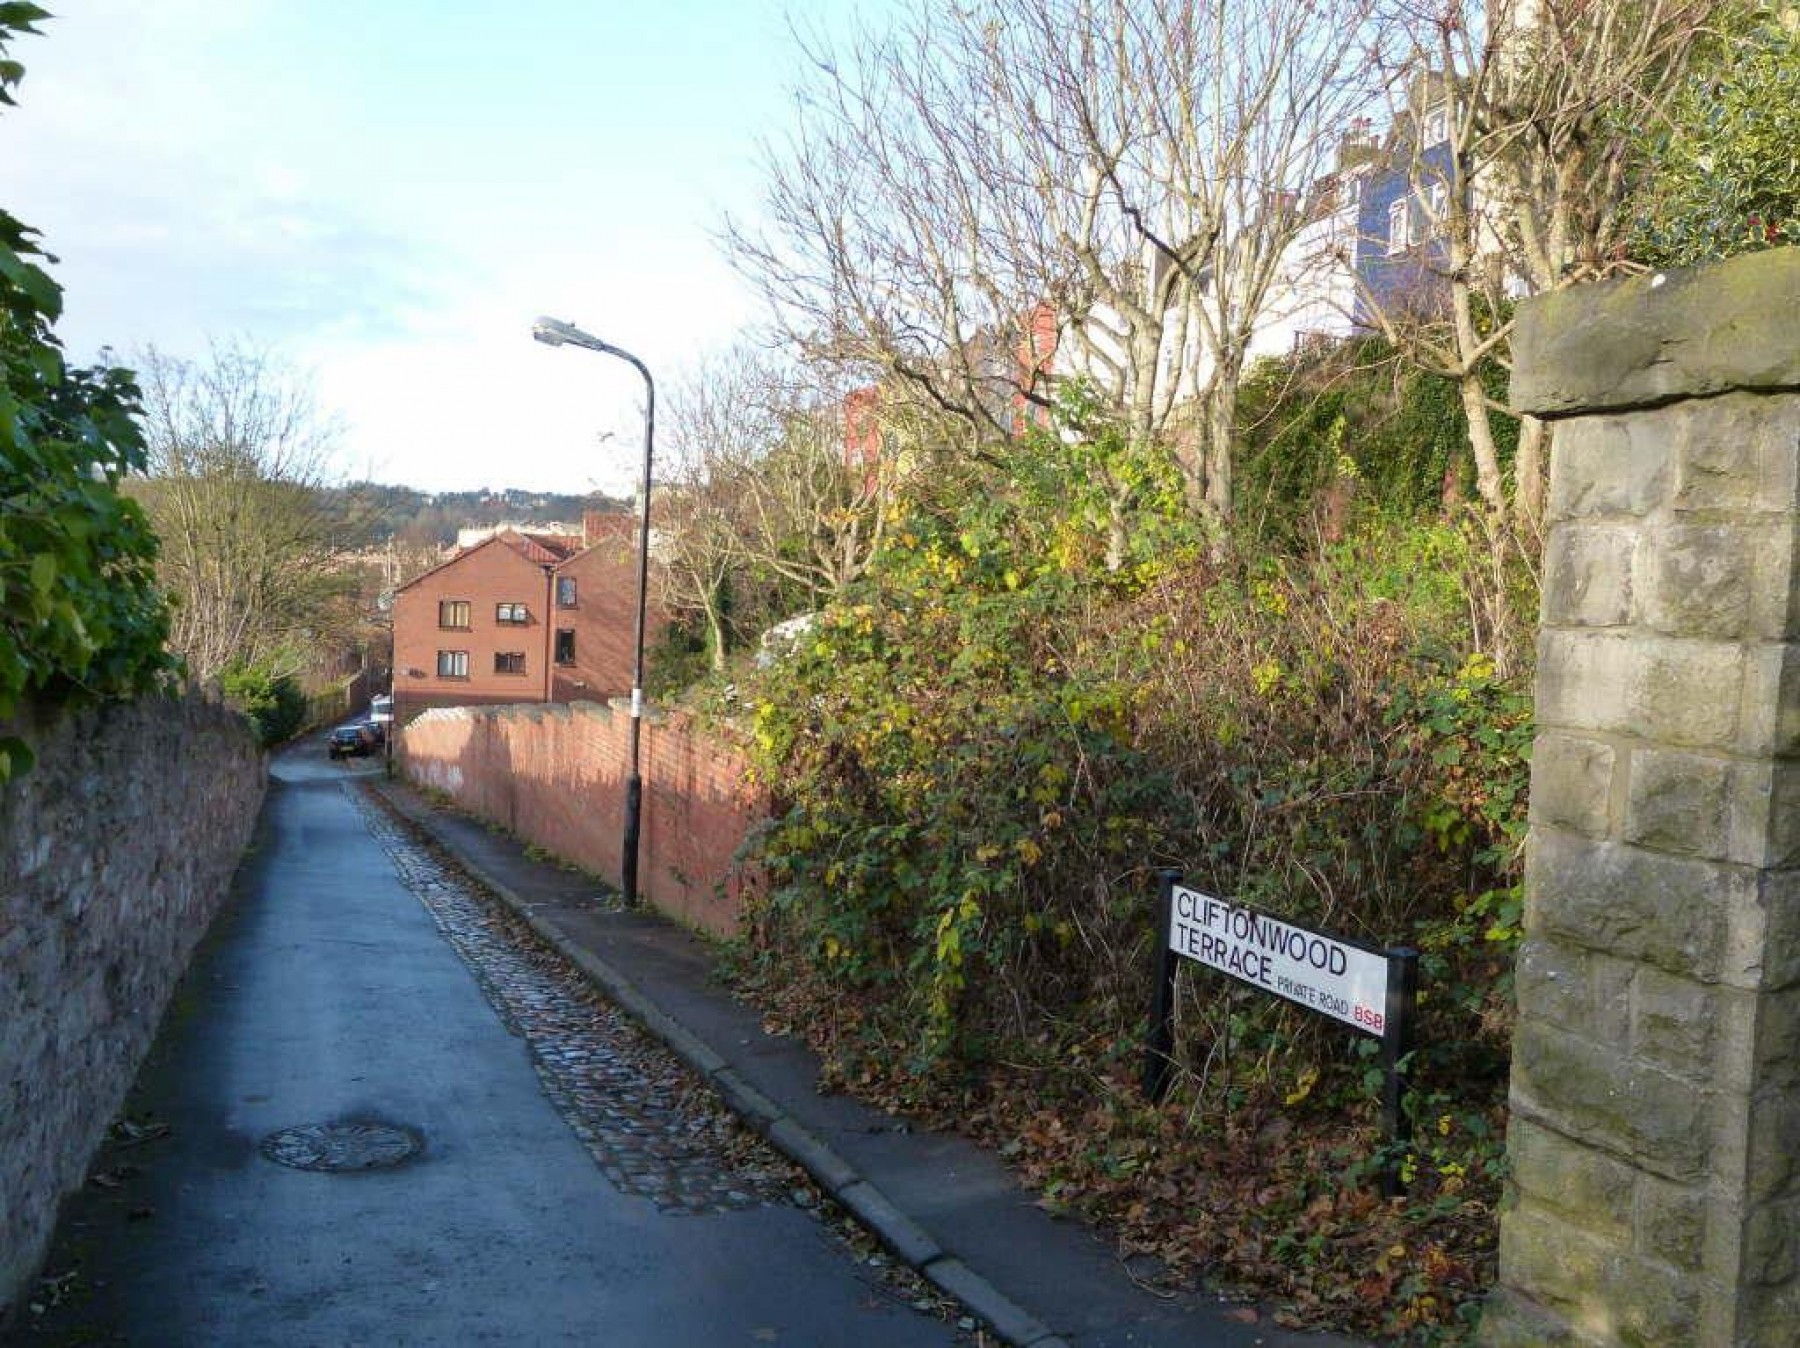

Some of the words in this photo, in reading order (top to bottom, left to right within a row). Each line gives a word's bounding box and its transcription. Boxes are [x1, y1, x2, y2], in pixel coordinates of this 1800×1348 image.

[1177, 892, 1347, 976] CLIFTONWOOD
[1177, 923, 1272, 985] TERRACE
[1277, 976, 1316, 1001] PRIVATE
[1319, 992, 1348, 1015] ROAD
